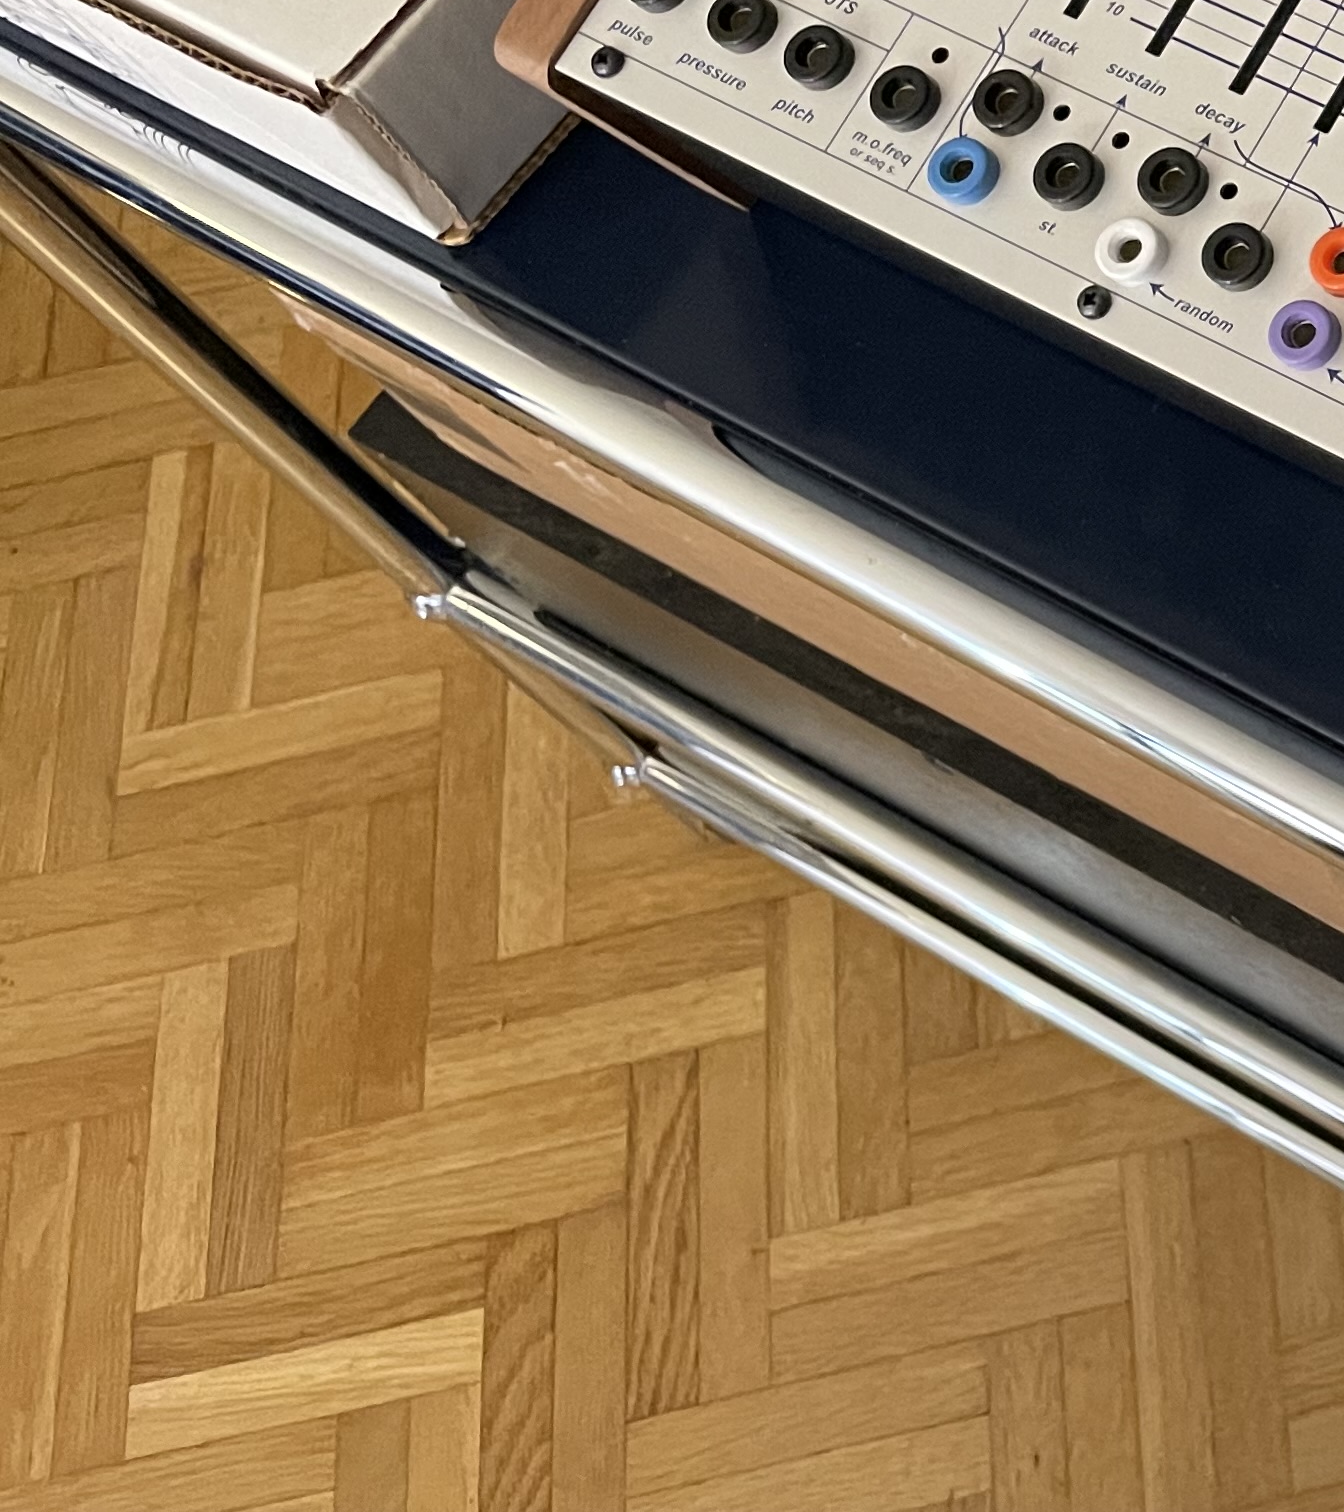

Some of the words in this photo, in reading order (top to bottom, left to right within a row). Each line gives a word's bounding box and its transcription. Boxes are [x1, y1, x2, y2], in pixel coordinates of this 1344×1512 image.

[607, 16, 655, 47] pulse
[1105, 61, 1169, 97] sustain
[770, 96, 817, 125] pitch
